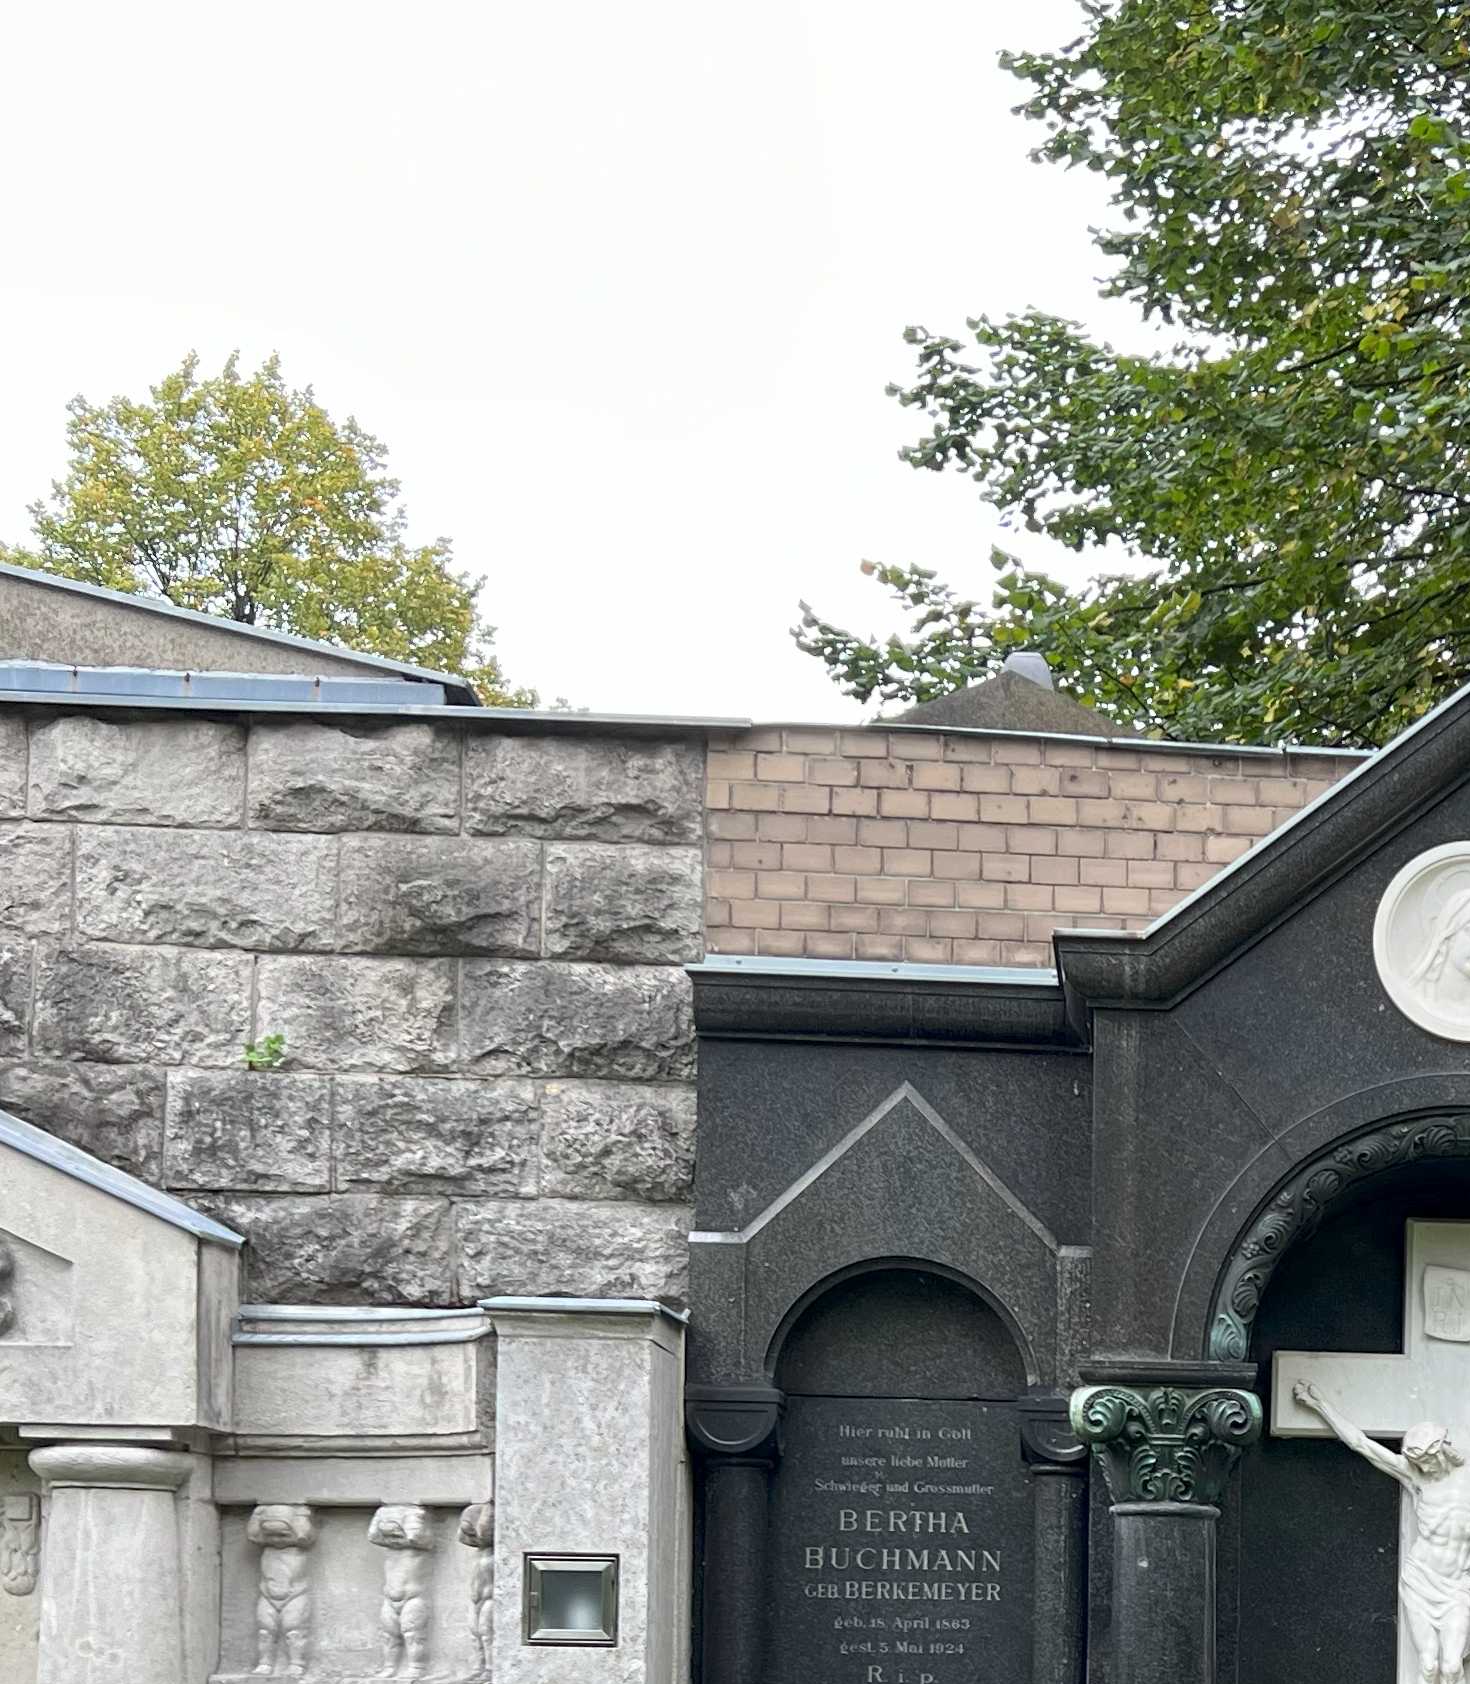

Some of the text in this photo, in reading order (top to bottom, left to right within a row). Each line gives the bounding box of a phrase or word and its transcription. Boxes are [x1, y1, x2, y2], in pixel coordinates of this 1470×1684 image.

[839, 1425, 972, 1440] Hier ruht in Gott
[841, 1456, 969, 1469] unsere liebe Mutter
[886, 1481, 909, 1493] und
[914, 1481, 995, 1496] Grossmutter
[839, 1509, 970, 1534] BERTHA
[804, 1546, 1001, 1572] BUCHMANN
[844, 1580, 1001, 1601] BERKEMEYER
[893, 1617, 929, 1632] April
[896, 1641, 924, 1654] Mai
[929, 1642, 965, 1655] 1924
